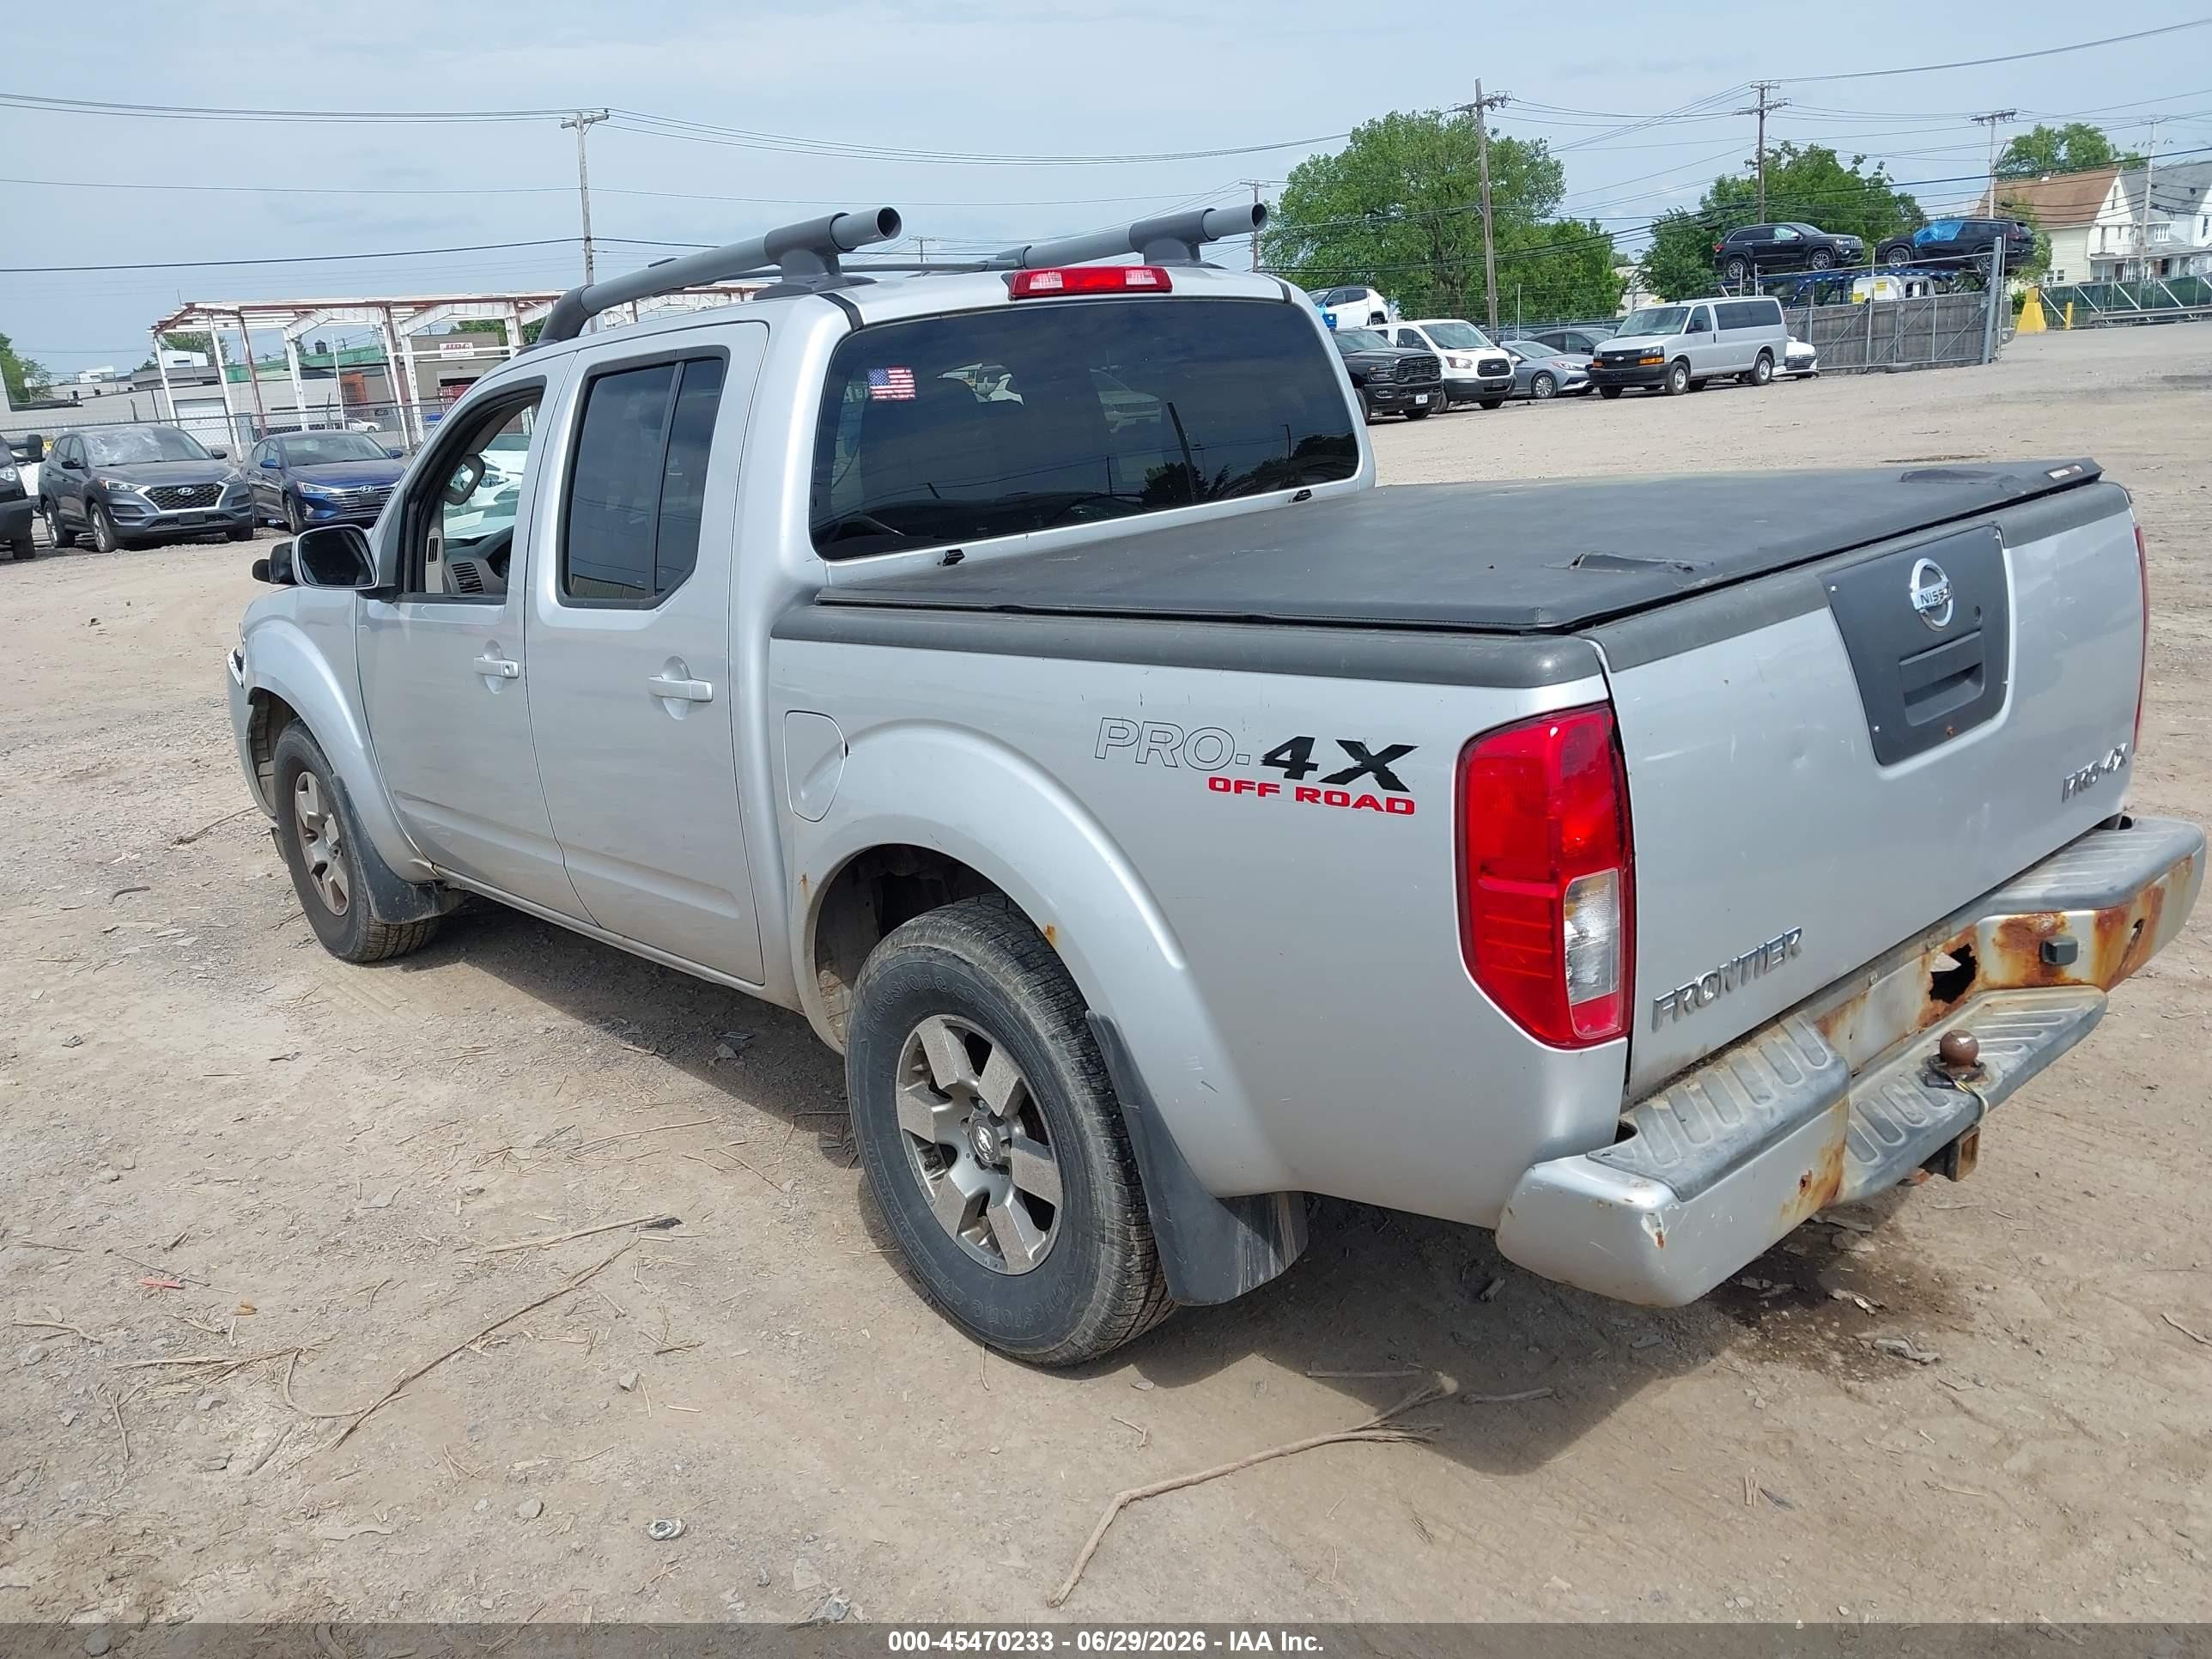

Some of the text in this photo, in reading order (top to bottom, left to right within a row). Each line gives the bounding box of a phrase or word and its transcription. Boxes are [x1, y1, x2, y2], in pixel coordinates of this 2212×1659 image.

[1920, 586, 1952, 605] NISS
[1208, 776, 1415, 815] OFF ROAD
[2062, 743, 2128, 803] PRO-4X
[1651, 926, 1802, 1031] FRONTIER
